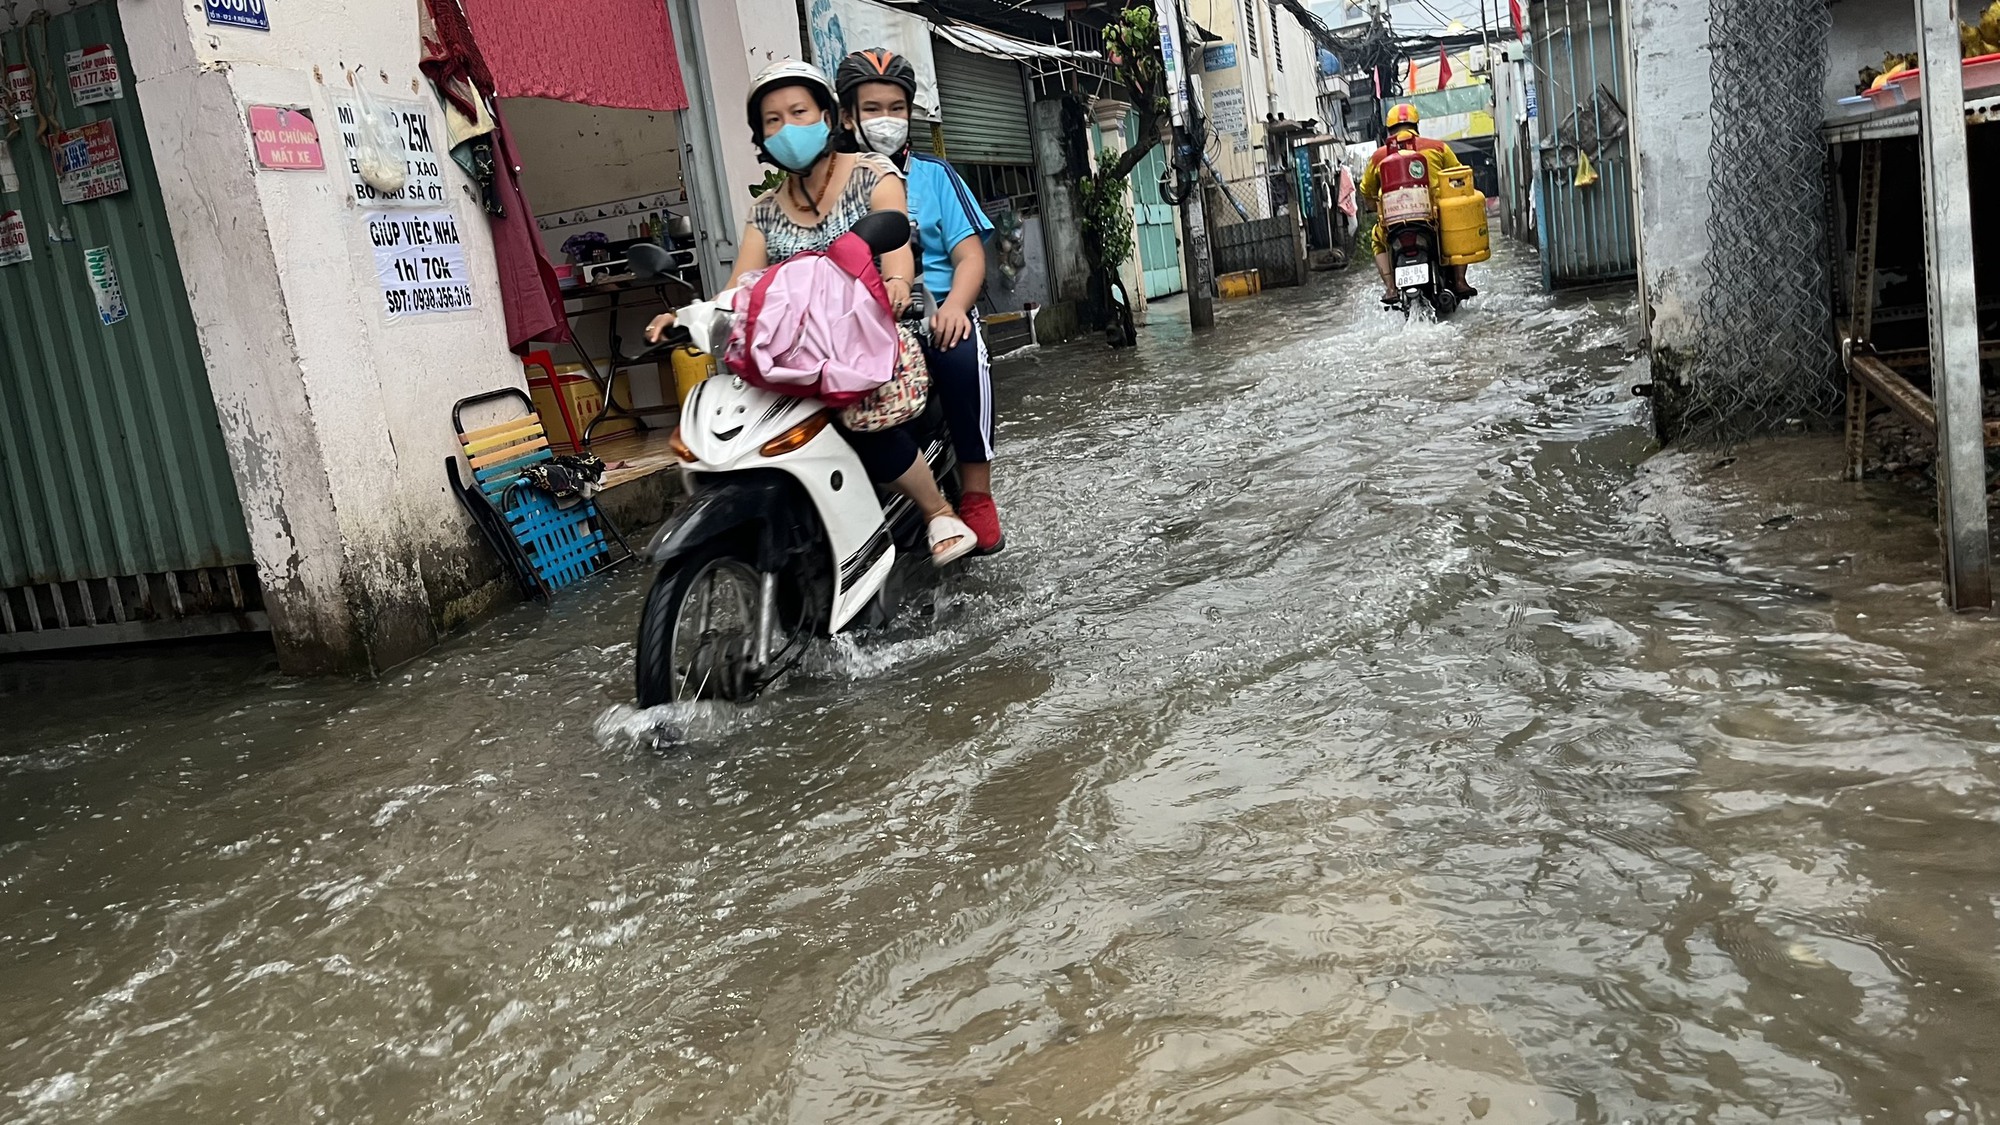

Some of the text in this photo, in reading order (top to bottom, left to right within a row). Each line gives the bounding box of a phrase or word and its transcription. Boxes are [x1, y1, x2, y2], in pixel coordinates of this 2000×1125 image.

[70, 68, 117, 88] 01.177.356
[257, 129, 277, 143] COI
[337, 103, 355, 124] MÌ
[402, 112, 433, 153] 25K
[271, 145, 312, 163] MẤT XE
[415, 157, 438, 177] XÀO
[408, 179, 425, 200] SẢ
[428, 181, 443, 201] ỚT
[369, 214, 460, 252] GIÚP VIỆC NHÀ
[394, 256, 453, 283] 1h/ 70k
[386, 284, 472, 313] SĐT: 0938.356.316
